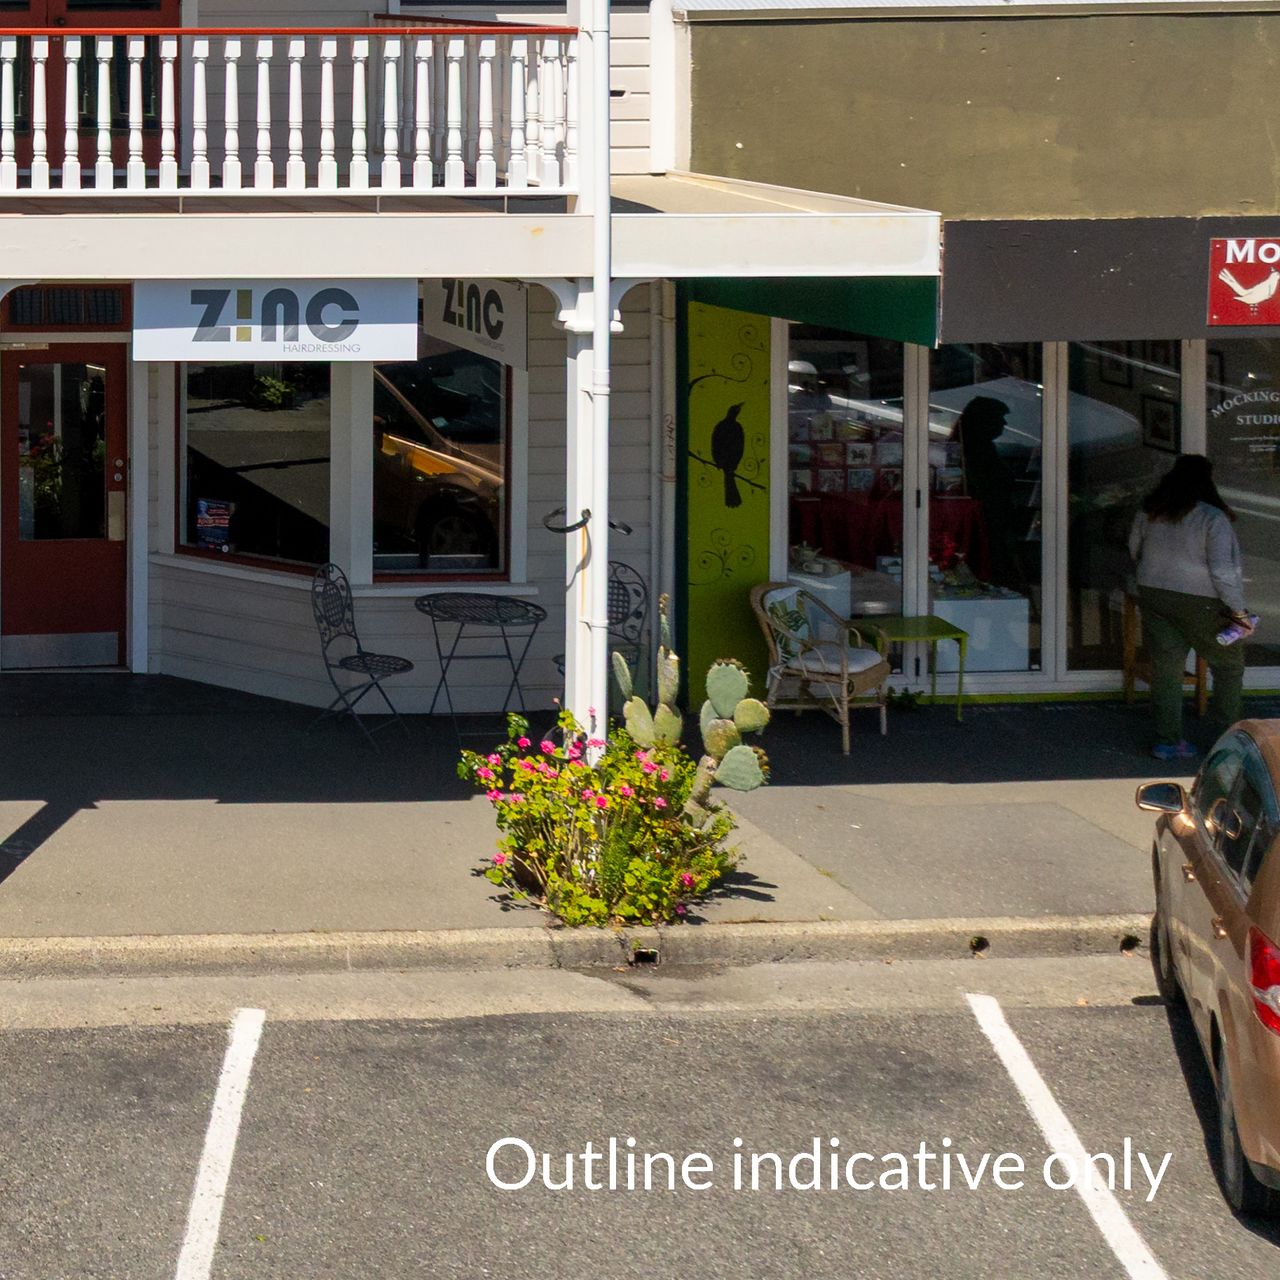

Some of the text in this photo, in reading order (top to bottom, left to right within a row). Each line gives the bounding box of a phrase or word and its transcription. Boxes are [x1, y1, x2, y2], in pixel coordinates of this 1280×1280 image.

[282, 343, 361, 353] HAIRDRESSING
[1211, 391, 1280, 418] MOCKING
[1236, 414, 1280, 425] STUDI
